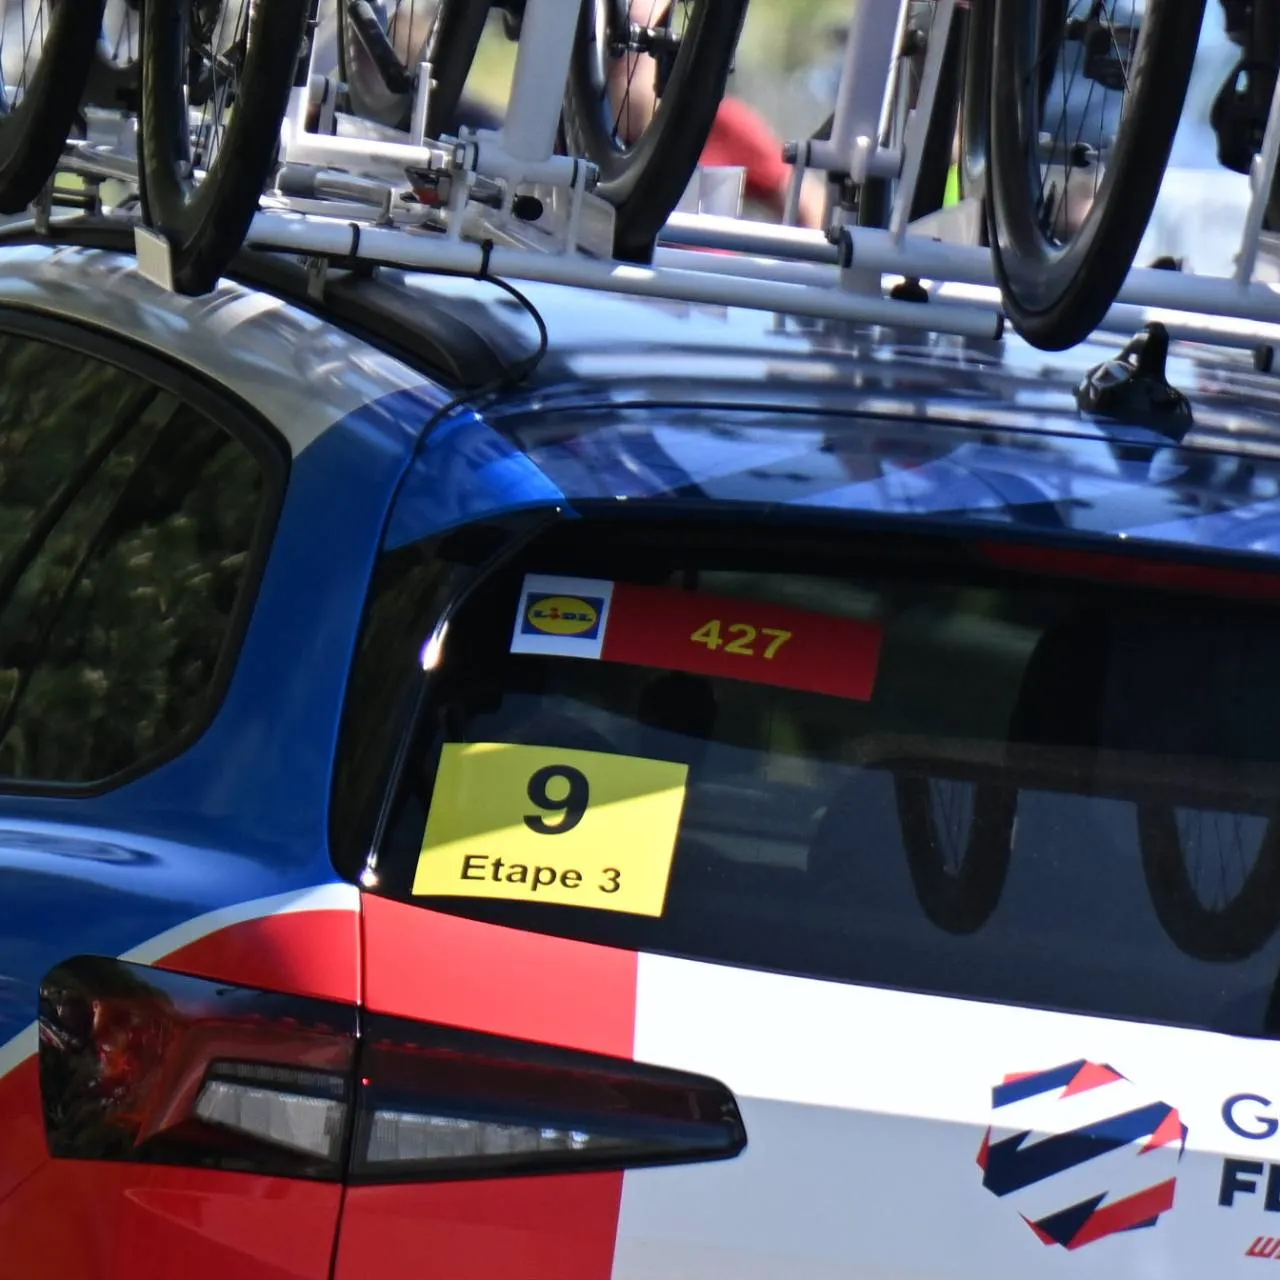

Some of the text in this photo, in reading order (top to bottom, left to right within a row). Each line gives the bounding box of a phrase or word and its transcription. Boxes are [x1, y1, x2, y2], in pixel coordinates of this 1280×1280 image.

[533, 607, 594, 622] LIDL
[690, 619, 793, 659] 427
[522, 764, 590, 835] 9
[460, 854, 622, 893] Etape 3
